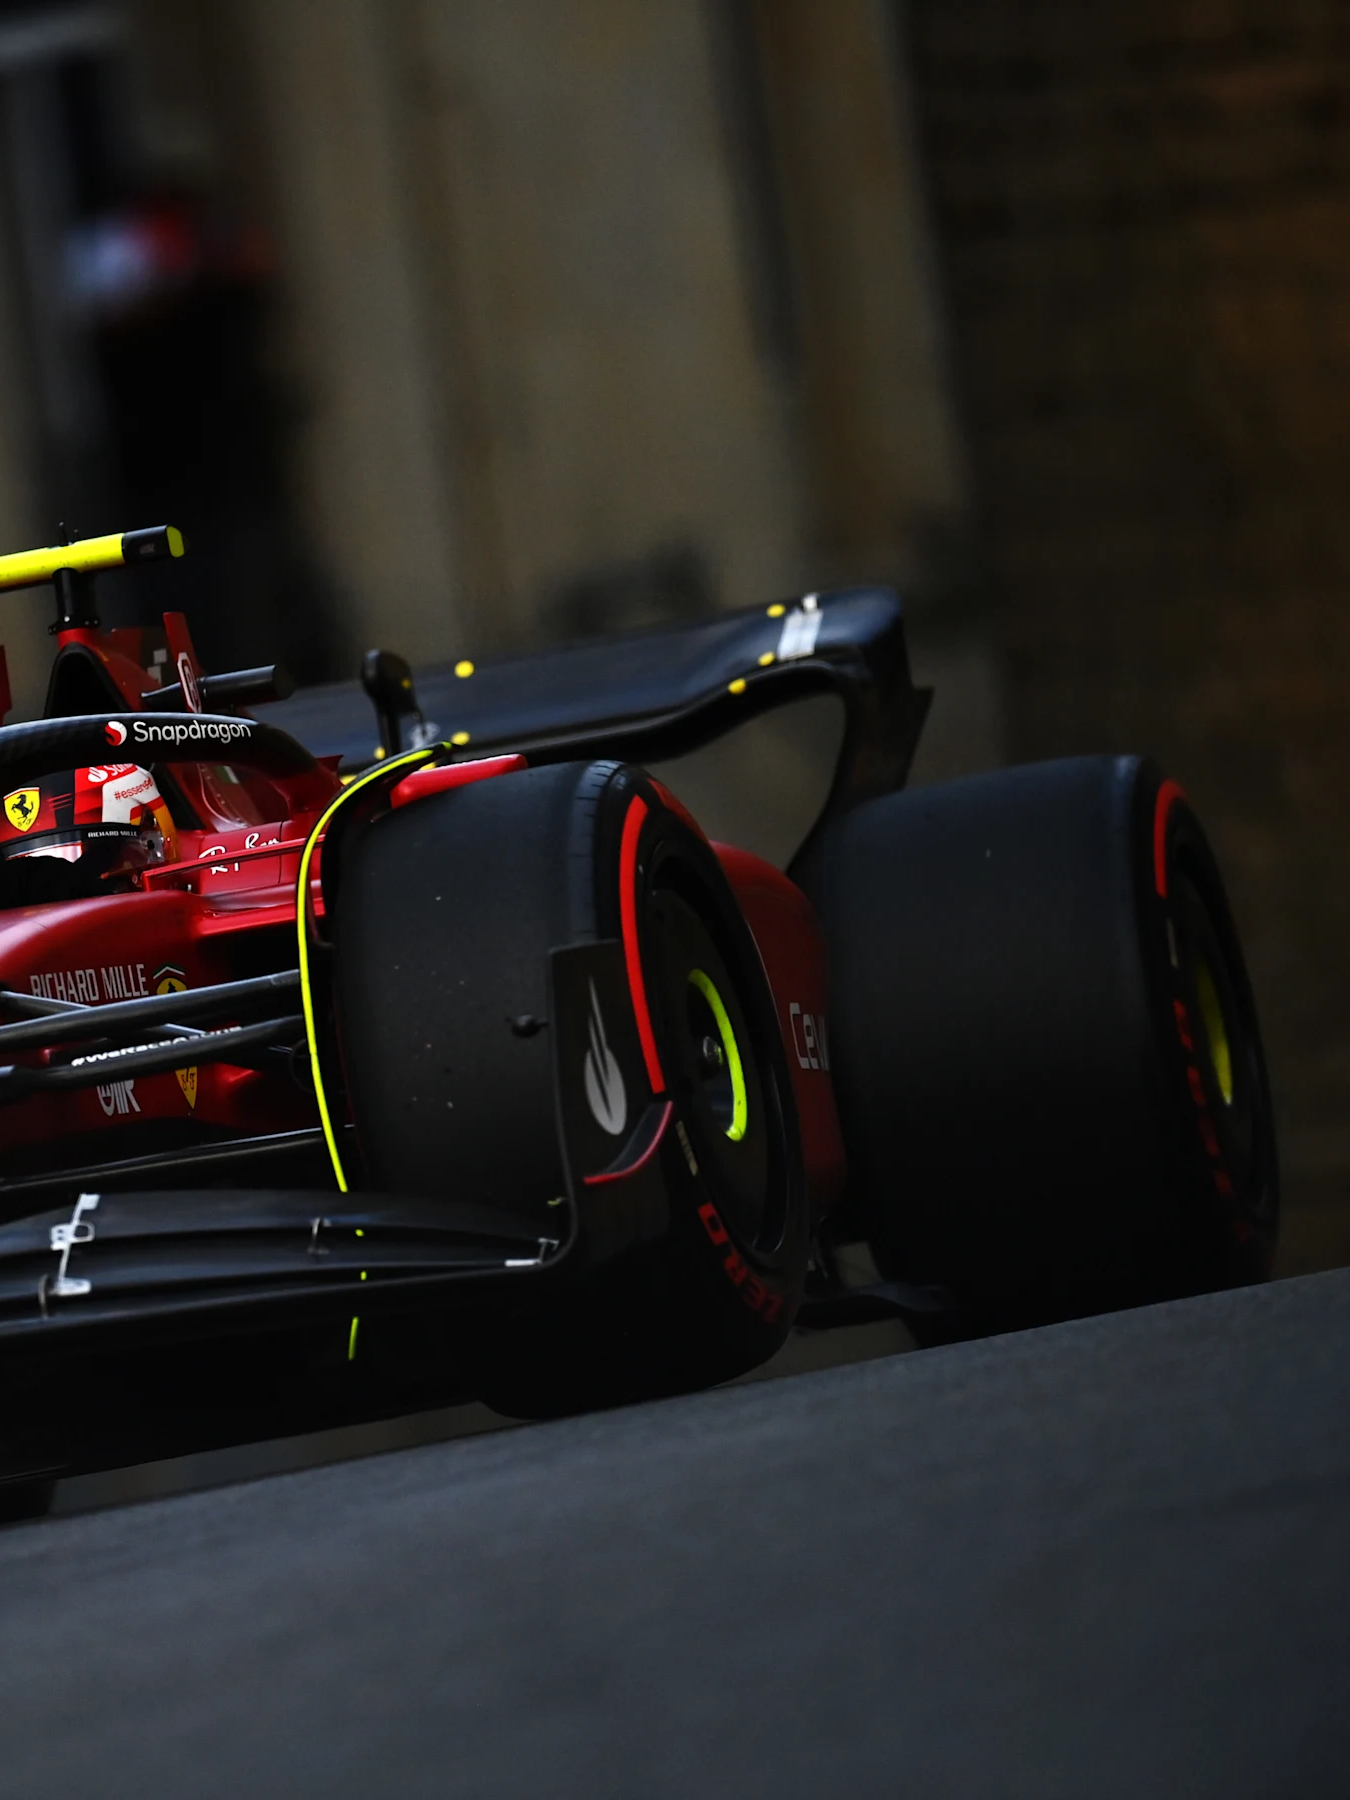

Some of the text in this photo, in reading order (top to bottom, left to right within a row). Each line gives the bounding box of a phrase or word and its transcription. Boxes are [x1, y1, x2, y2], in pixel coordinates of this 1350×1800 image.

[133, 719, 252, 745] Snapdragon
[87, 830, 120, 839] RICHARD
[29, 963, 150, 1004] RICHARD MILLE
